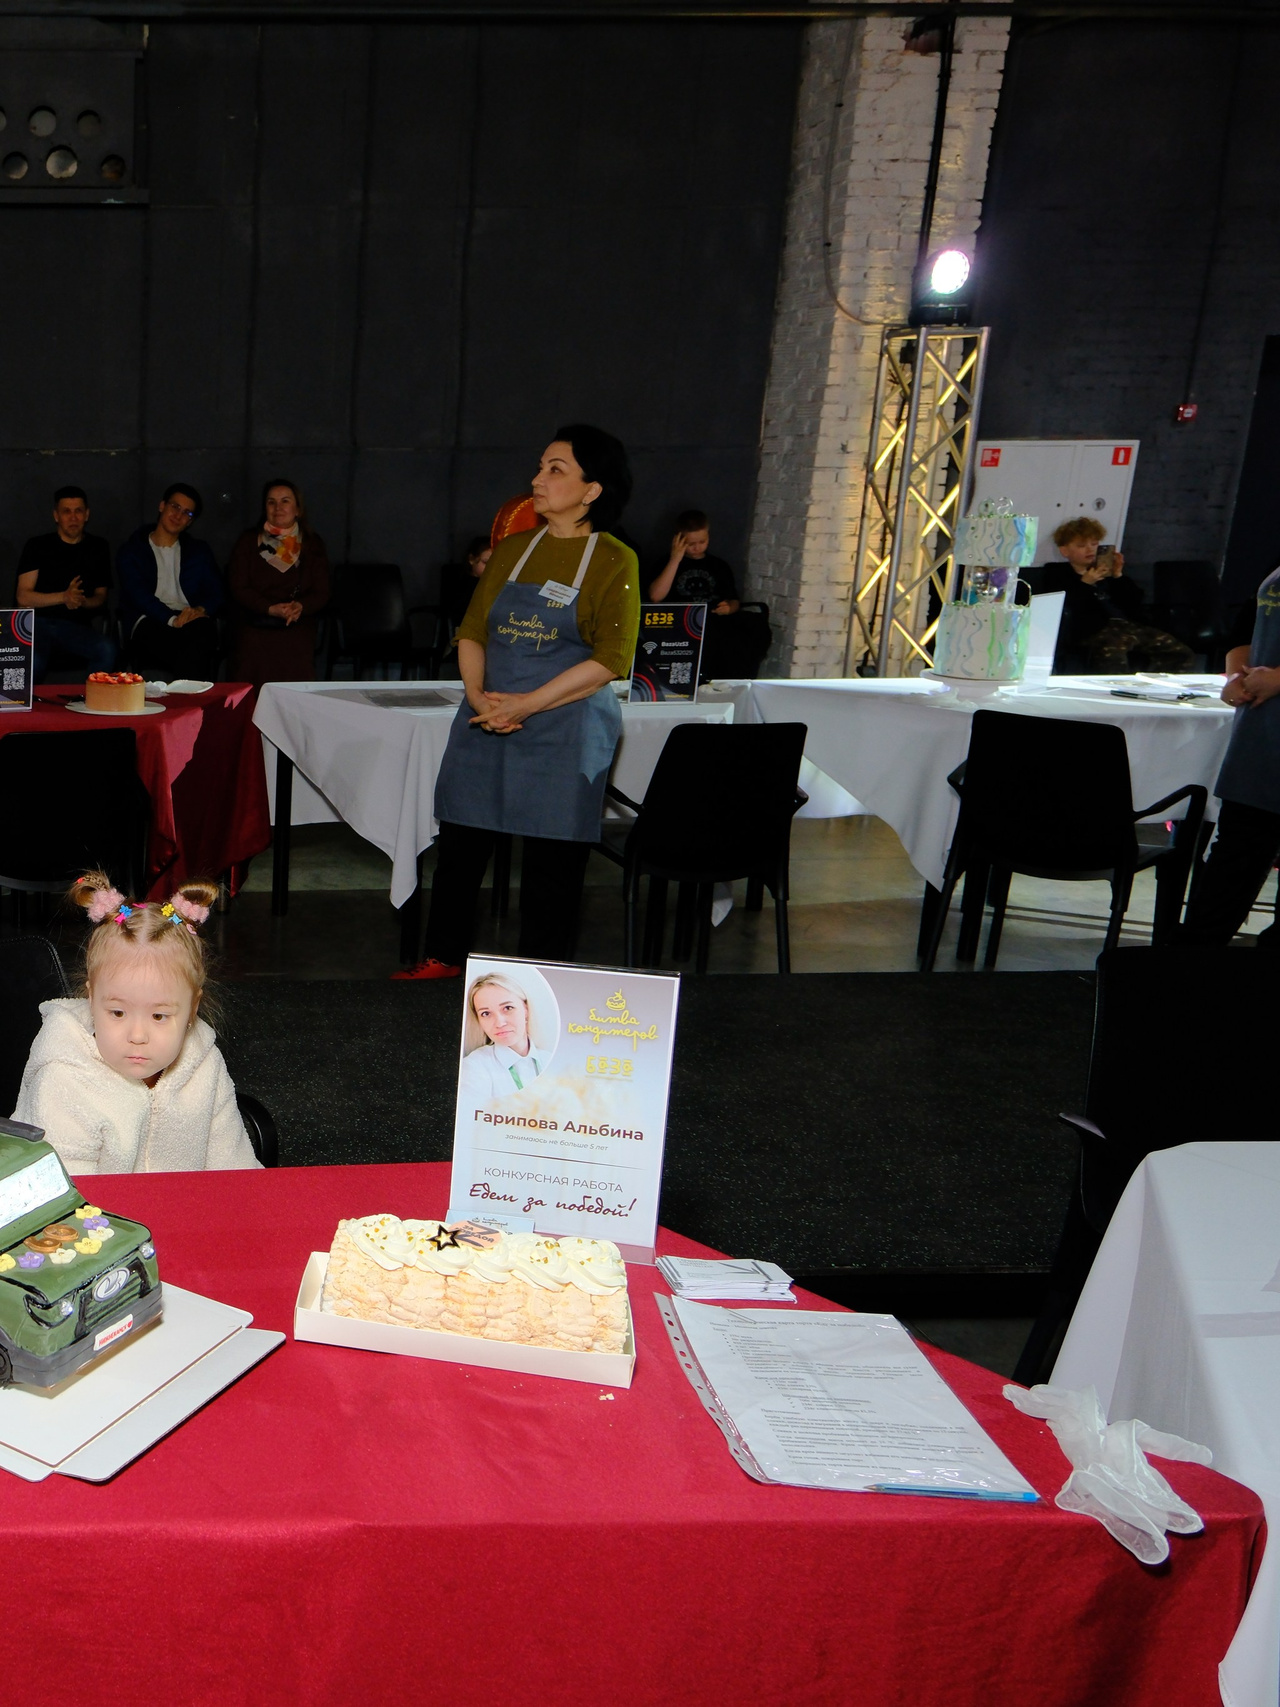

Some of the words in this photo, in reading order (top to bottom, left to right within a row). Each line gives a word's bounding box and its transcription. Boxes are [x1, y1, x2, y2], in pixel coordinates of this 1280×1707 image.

[589, 1008, 640, 1025] битва
[568, 1023, 659, 1051] кондитеров
[474, 1109, 558, 1131] Гарипова
[563, 1120, 644, 1141] Альбина
[505, 1134, 547, 1144] занимаюсь
[560, 1139, 588, 1149] больше
[484, 1167, 569, 1186] КОНКУРСНАЯ
[573, 1178, 623, 1193] РАБОТА
[469, 1183, 518, 1203] Едем
[523, 1197, 547, 1213] за
[556, 1195, 637, 1218] победой!
